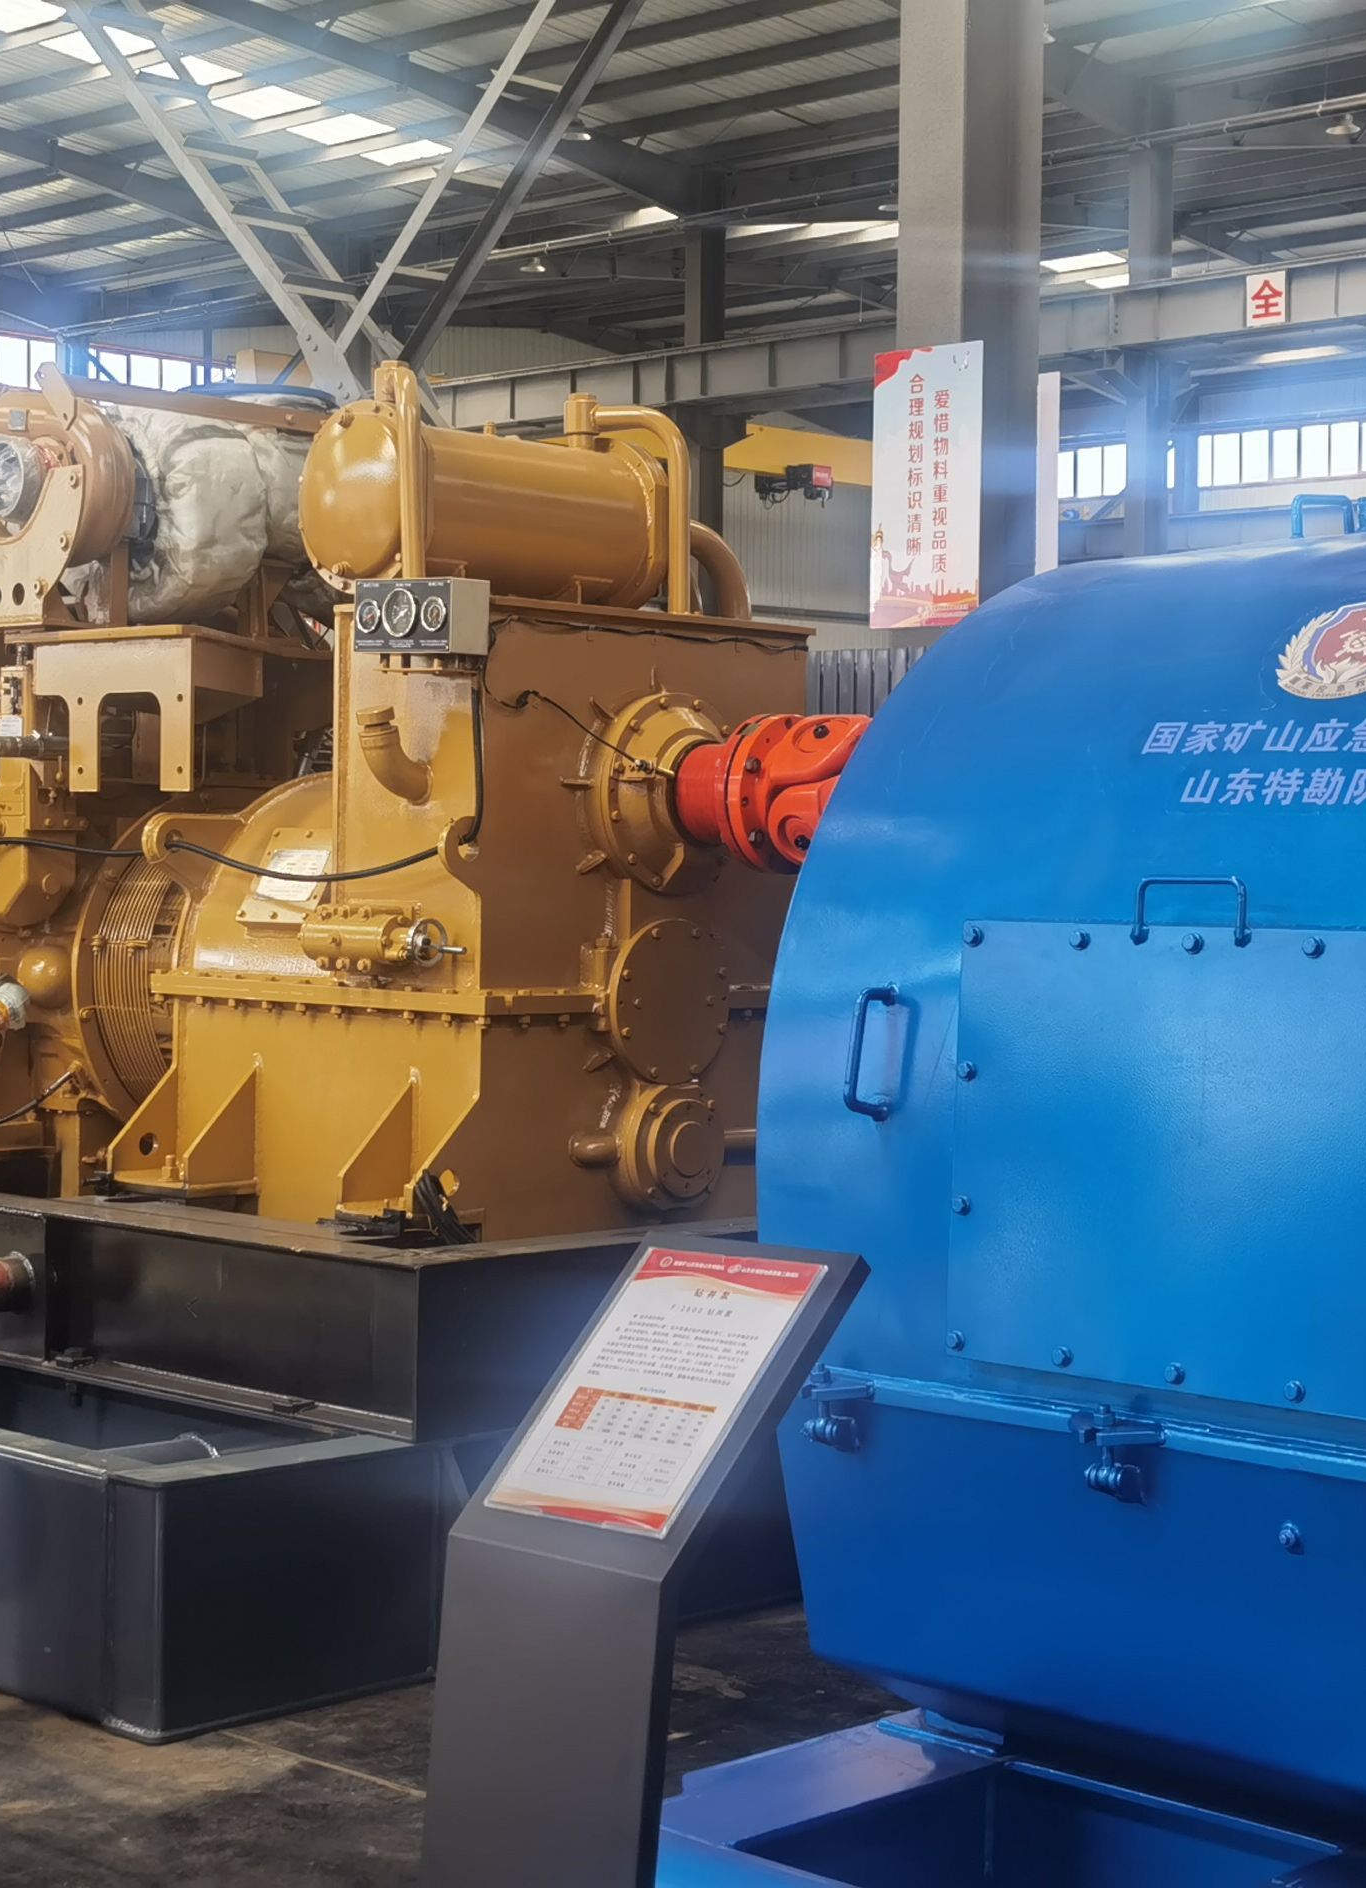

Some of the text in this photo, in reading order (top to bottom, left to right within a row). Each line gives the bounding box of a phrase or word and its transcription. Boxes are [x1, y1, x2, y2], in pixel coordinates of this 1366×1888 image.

[1250, 279, 1284, 319] 全
[906, 373, 925, 557] 合理规划标识清晰
[931, 388, 950, 574] 爱惜物料重视品质
